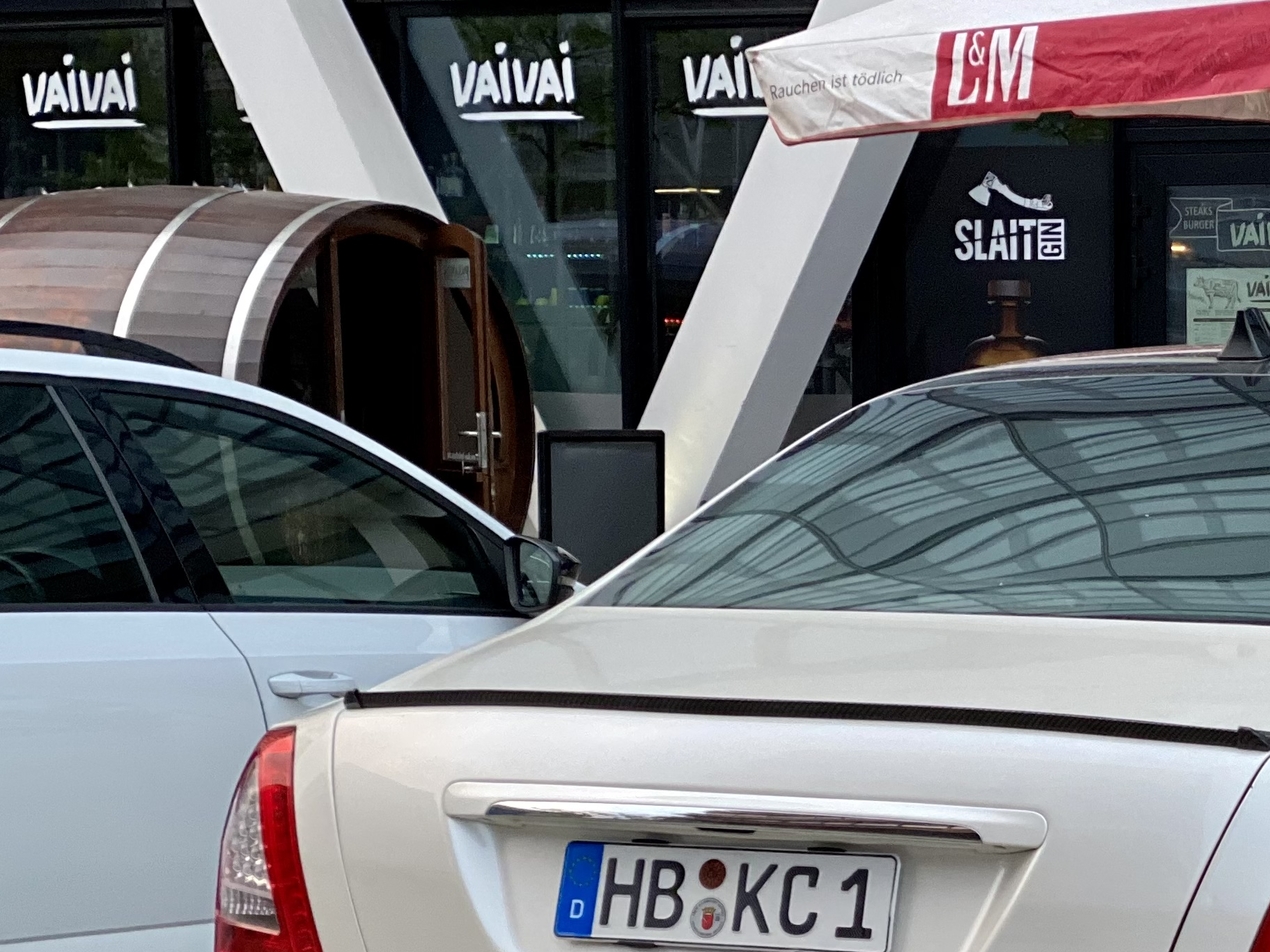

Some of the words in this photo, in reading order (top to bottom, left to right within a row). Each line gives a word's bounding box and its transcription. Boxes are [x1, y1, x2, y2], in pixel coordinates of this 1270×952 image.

[947, 26, 1038, 106] L&M
[769, 78, 826, 101] Rauchen
[831, 74, 847, 89] ist
[852, 70, 903, 87] tödlich
[1183, 220, 1215, 230] BURGER
[1184, 206, 1213, 216] STEAKS
[954, 219, 1036, 260] SLAIT
[1041, 222, 1062, 257] GIN
[599, 857, 686, 928] HB
[569, 898, 585, 919] D
